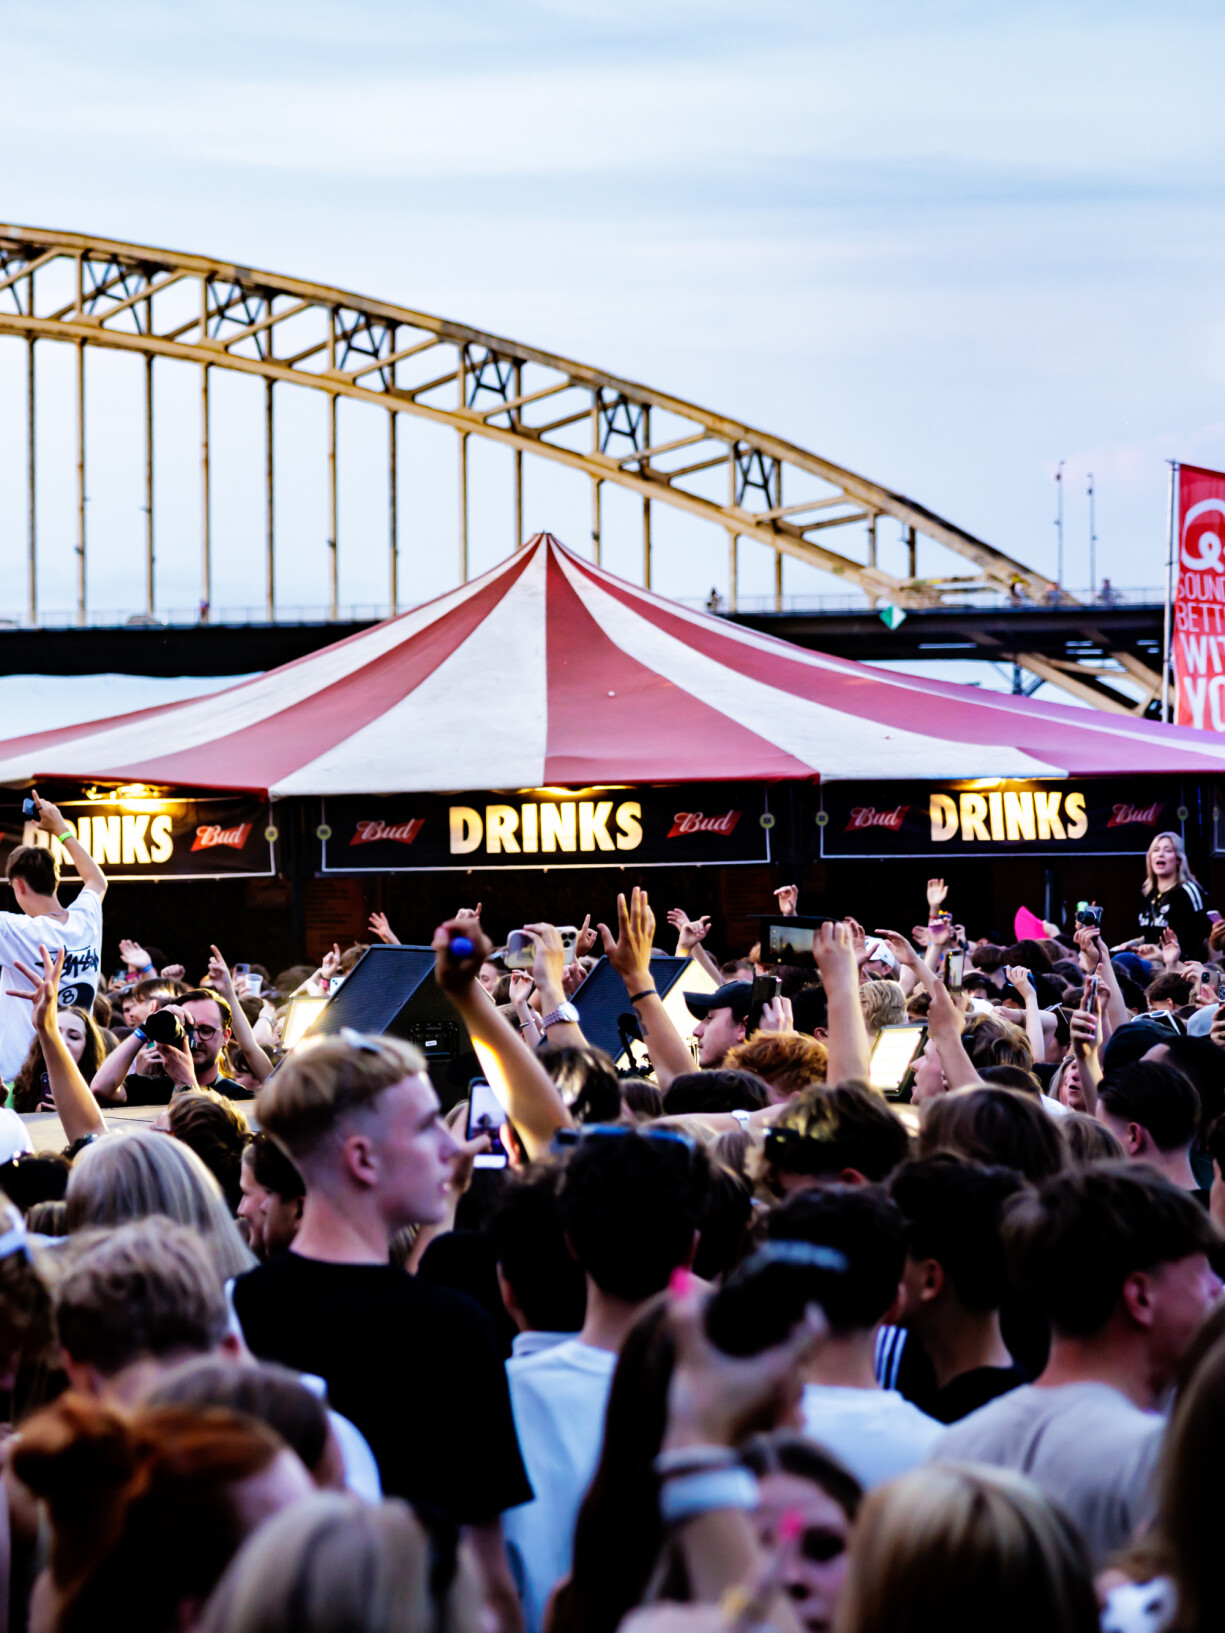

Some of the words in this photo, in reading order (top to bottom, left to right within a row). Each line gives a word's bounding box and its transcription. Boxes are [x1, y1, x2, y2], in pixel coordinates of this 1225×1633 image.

[1176, 602, 1225, 633] BETT
[356, 818, 416, 840] Bud
[449, 801, 643, 855] DRINKS
[674, 809, 734, 833] Bud
[850, 805, 902, 827] Bud
[929, 791, 1088, 842] DRINKS
[1112, 802, 1158, 824] Bud
[196, 823, 245, 846] Bud
[62, 990, 75, 1004] 8
